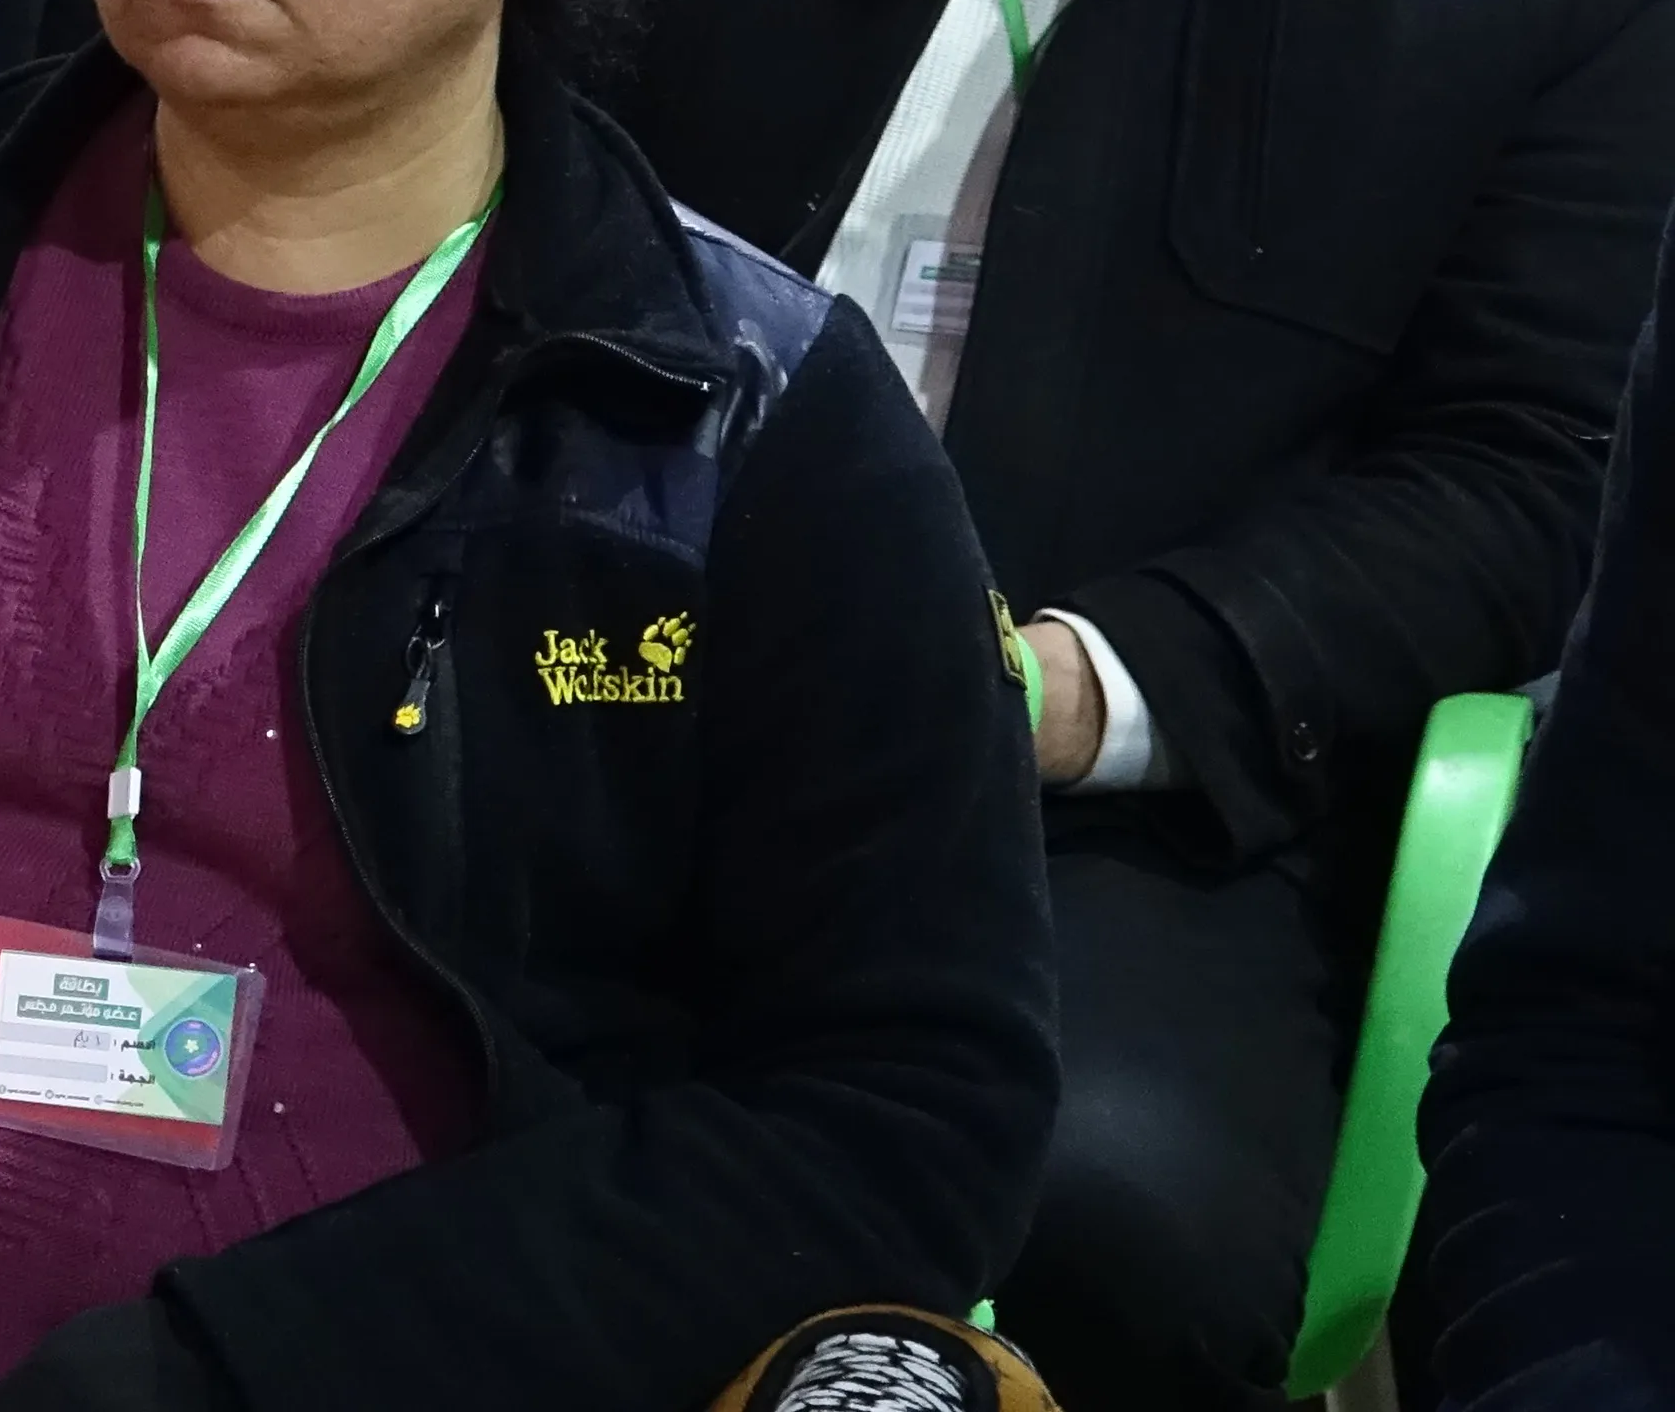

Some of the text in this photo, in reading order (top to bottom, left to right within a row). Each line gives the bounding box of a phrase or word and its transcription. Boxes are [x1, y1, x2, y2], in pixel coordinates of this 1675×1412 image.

[535, 629, 609, 666] Jack
[58, 976, 103, 997] بطاقة
[103, 1006, 138, 1021] عضو
